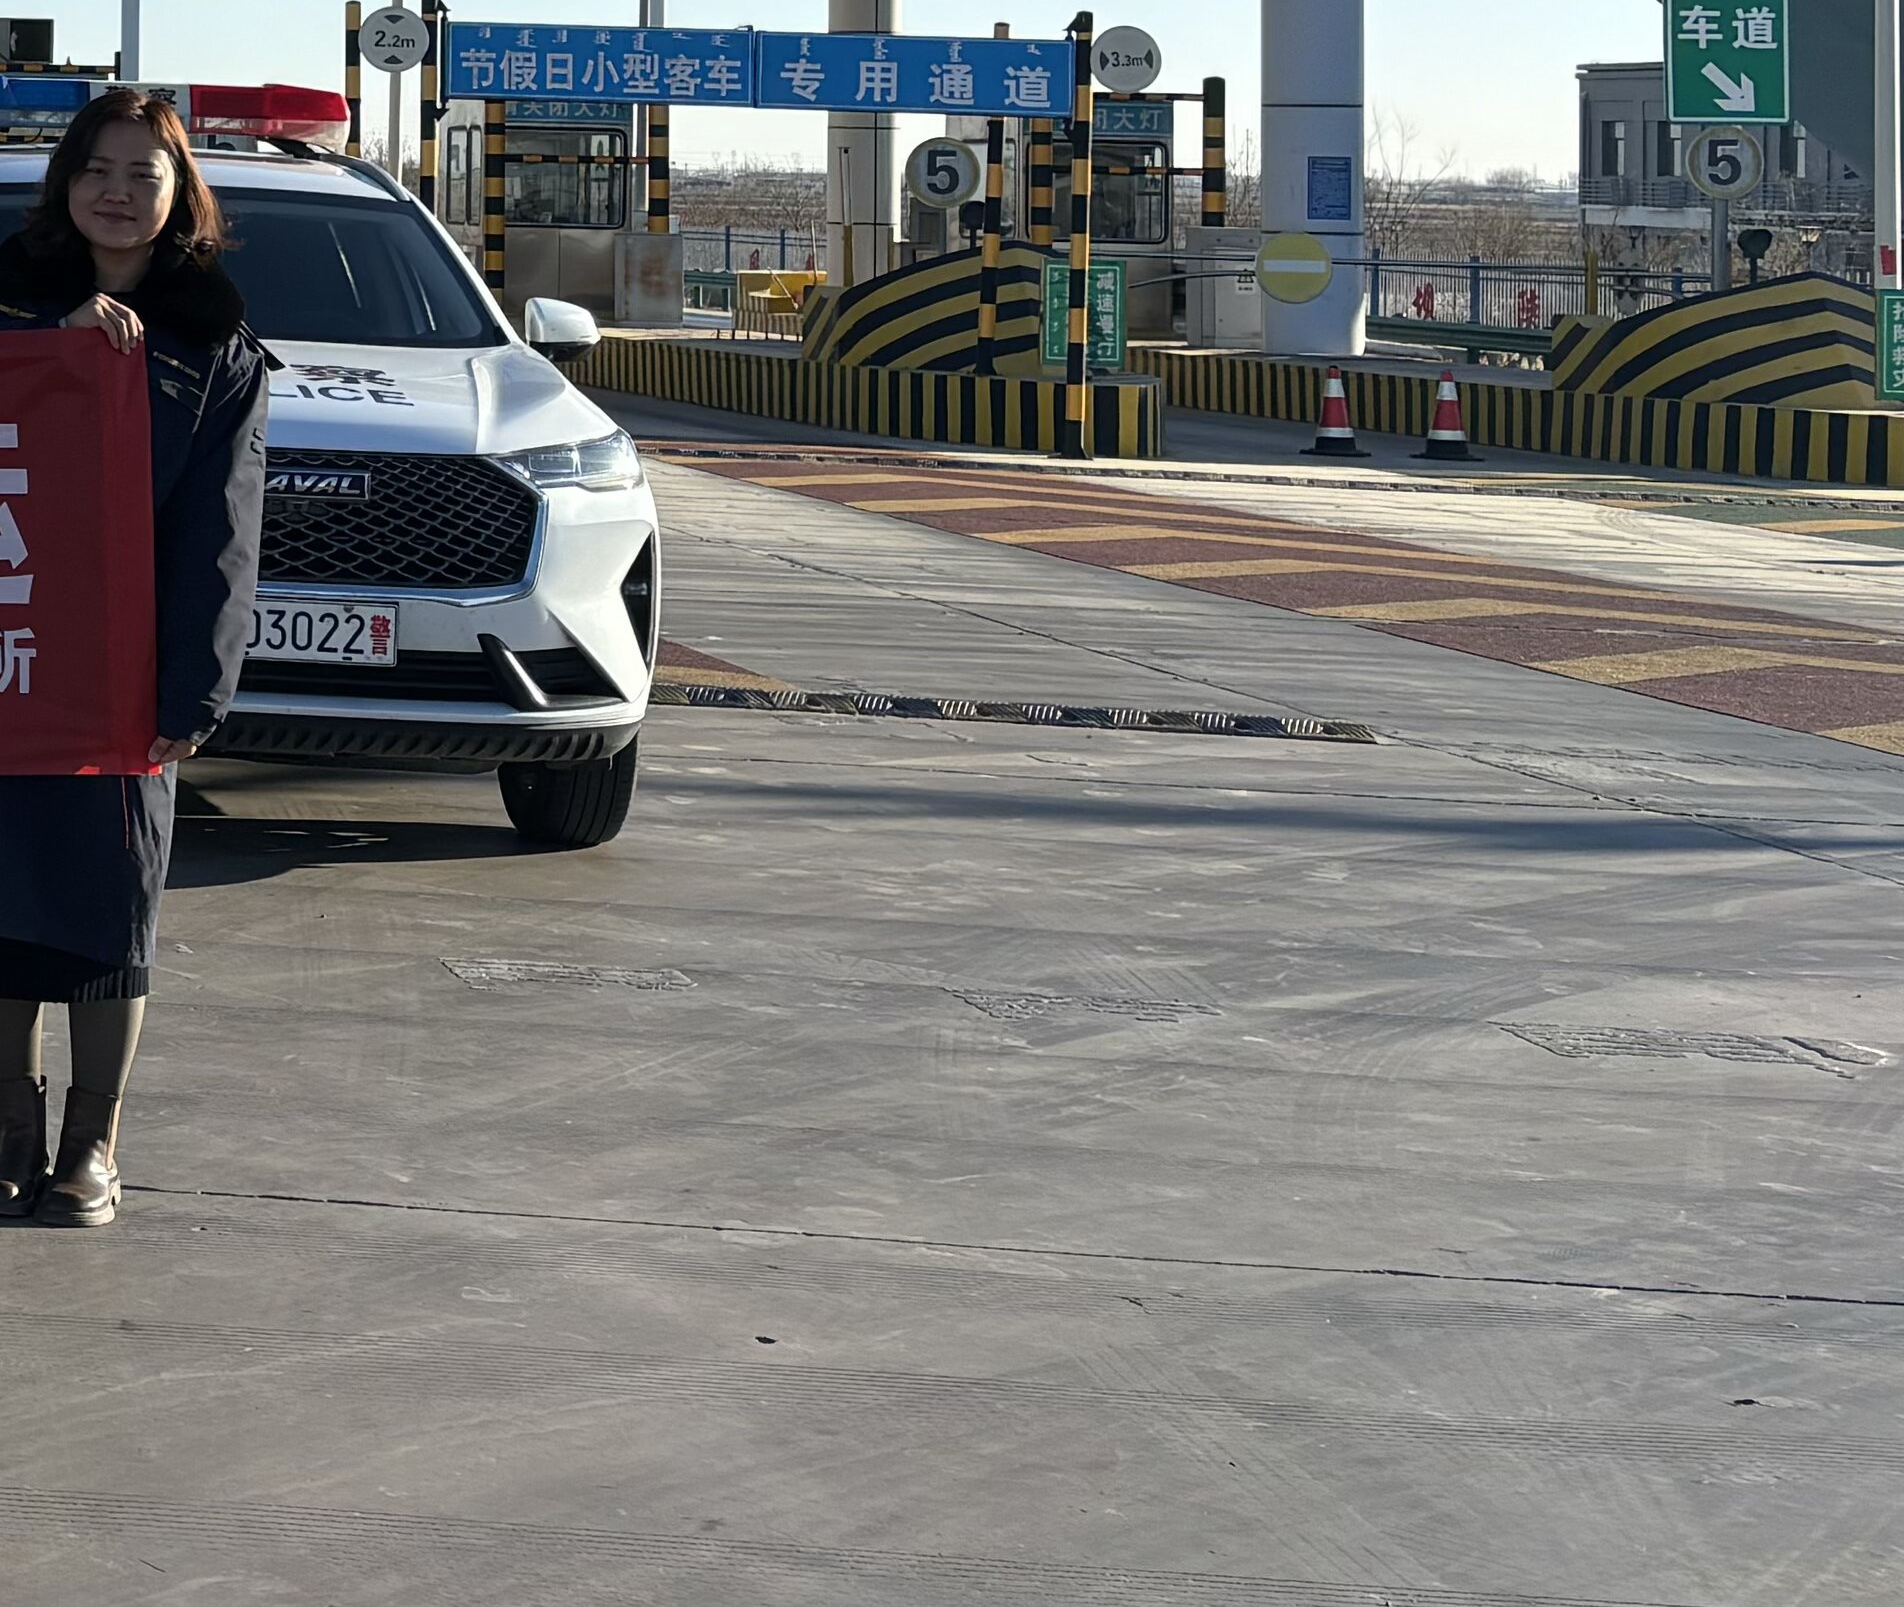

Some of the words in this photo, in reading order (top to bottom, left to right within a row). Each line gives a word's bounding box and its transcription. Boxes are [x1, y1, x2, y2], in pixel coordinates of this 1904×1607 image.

[374, 30, 416, 49] 2.2m
[1678, 5, 1778, 49] 车道
[460, 48, 742, 97] 节假日小型客车
[1111, 50, 1143, 68] 3.3m
[780, 57, 1052, 109] 专用通道
[926, 150, 958, 194] 5
[1707, 139, 1742, 186] 5
